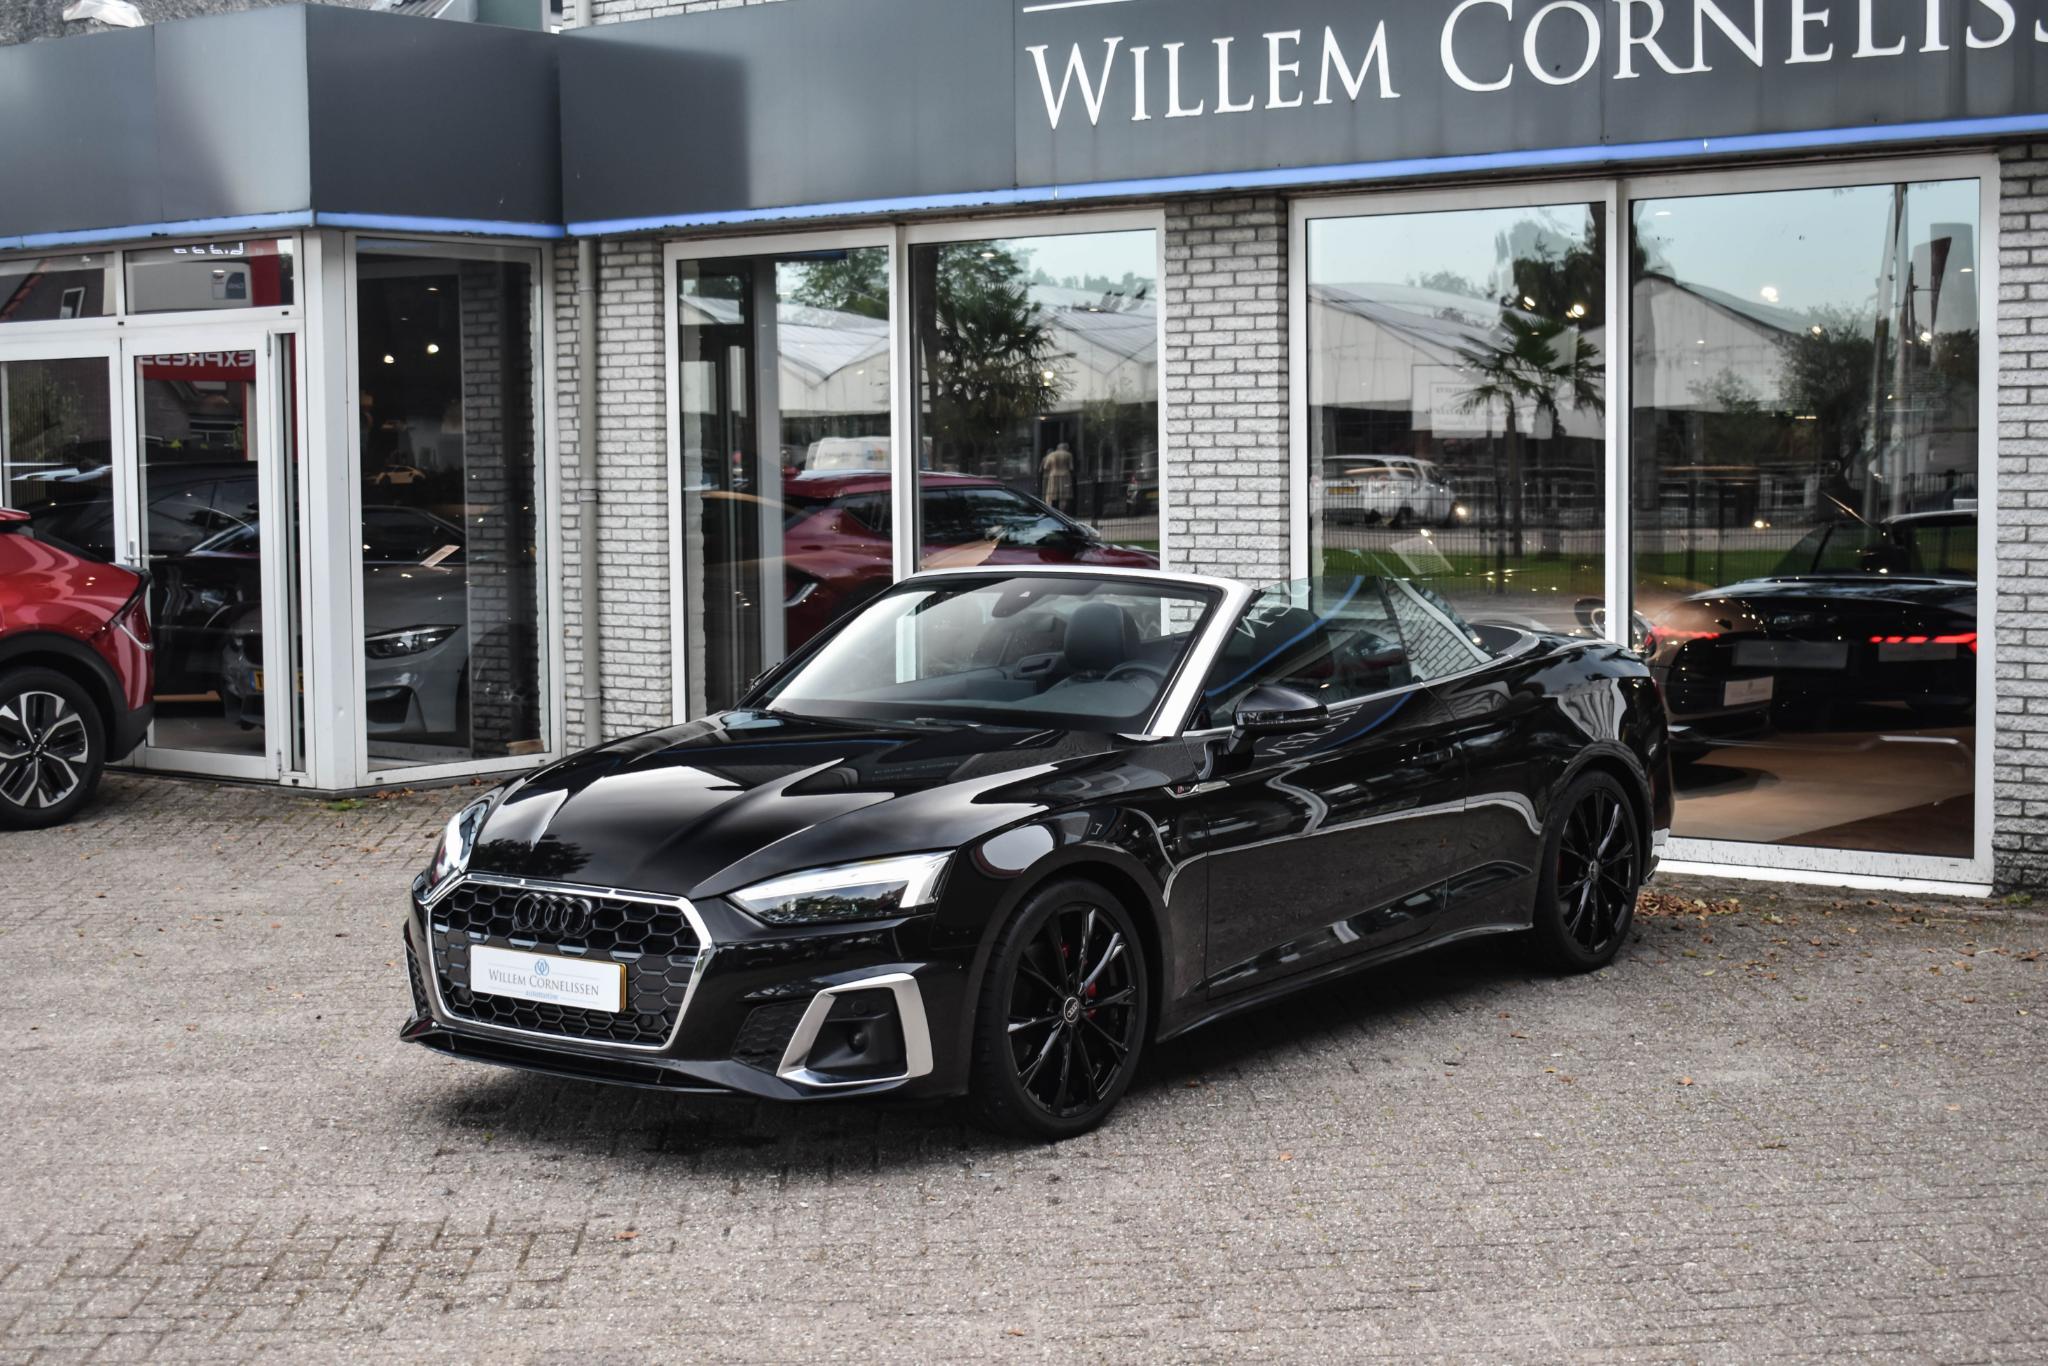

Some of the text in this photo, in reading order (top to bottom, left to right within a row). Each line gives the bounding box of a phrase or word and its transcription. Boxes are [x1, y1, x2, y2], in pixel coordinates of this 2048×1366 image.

[1025, 0, 2048, 130] WILLEM CORNELIS
[488, 968, 599, 996] WILLEM CORNELISSEN
